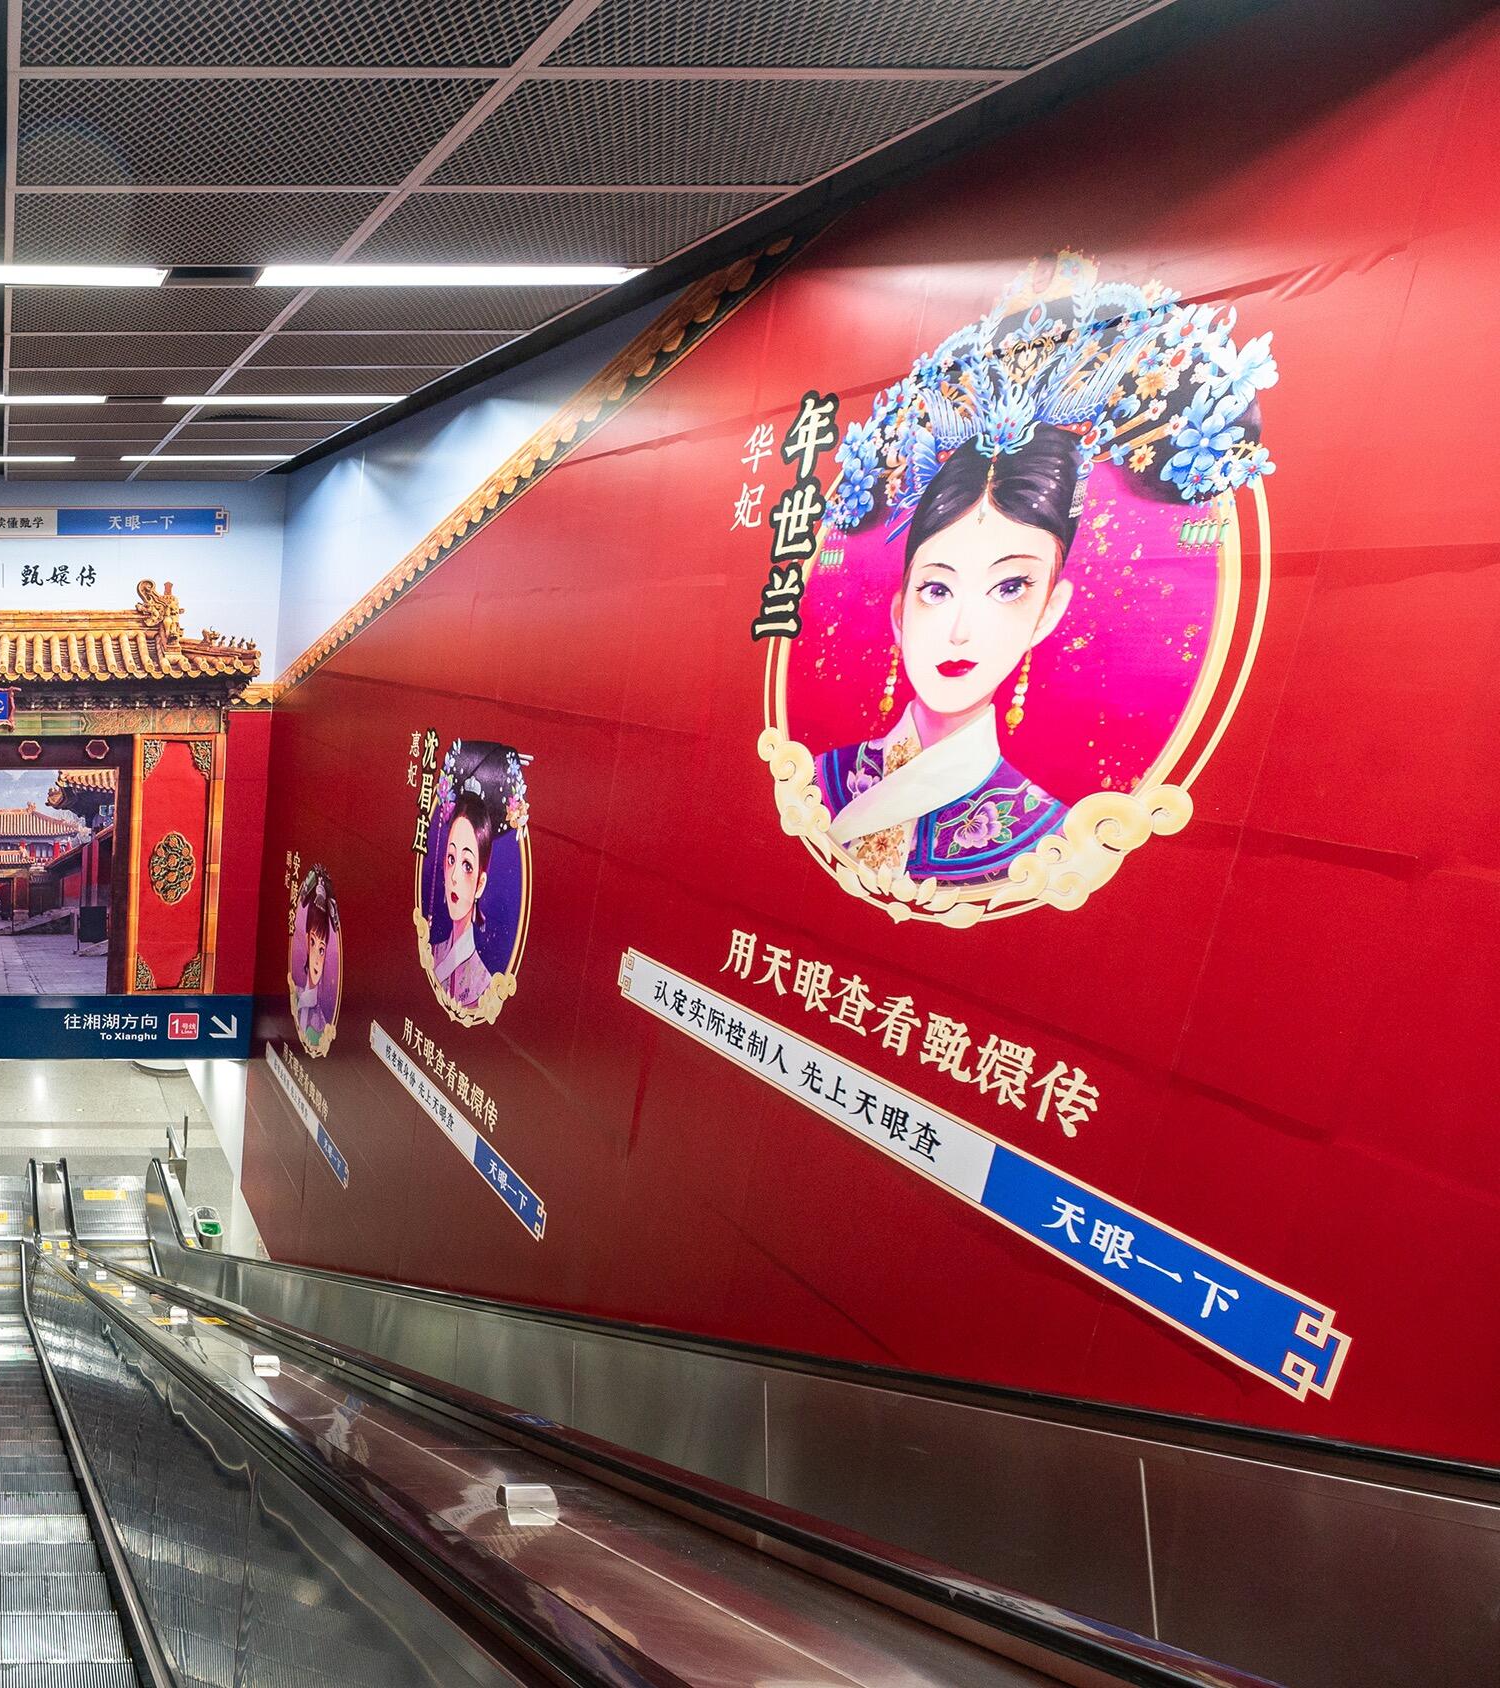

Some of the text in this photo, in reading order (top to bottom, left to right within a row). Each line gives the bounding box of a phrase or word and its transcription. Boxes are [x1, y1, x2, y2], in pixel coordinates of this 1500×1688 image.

[730, 423, 775, 532] 华妃
[107, 515, 175, 531] 天眼一下
[754, 397, 836, 636] 年世兰
[20, 564, 98, 587] 甄嬛传
[406, 730, 421, 788] 惠妃
[412, 730, 439, 854] 沈眉庄
[64, 1013, 158, 1030] 往湘湖方向
[100, 1031, 157, 1042] To Xianghu
[172, 1018, 180, 1034] 1
[719, 928, 1100, 1138] 用天眼查看甄嬛传
[401, 1017, 498, 1133] 用天眼查看甄嬛传
[653, 979, 943, 1163] 认定实际控制人 先上天眼查
[418, 1083, 455, 1132] 先上天眼查
[488, 1159, 528, 1210] 天眼一下
[1041, 1196, 1241, 1320] 天眼一下
